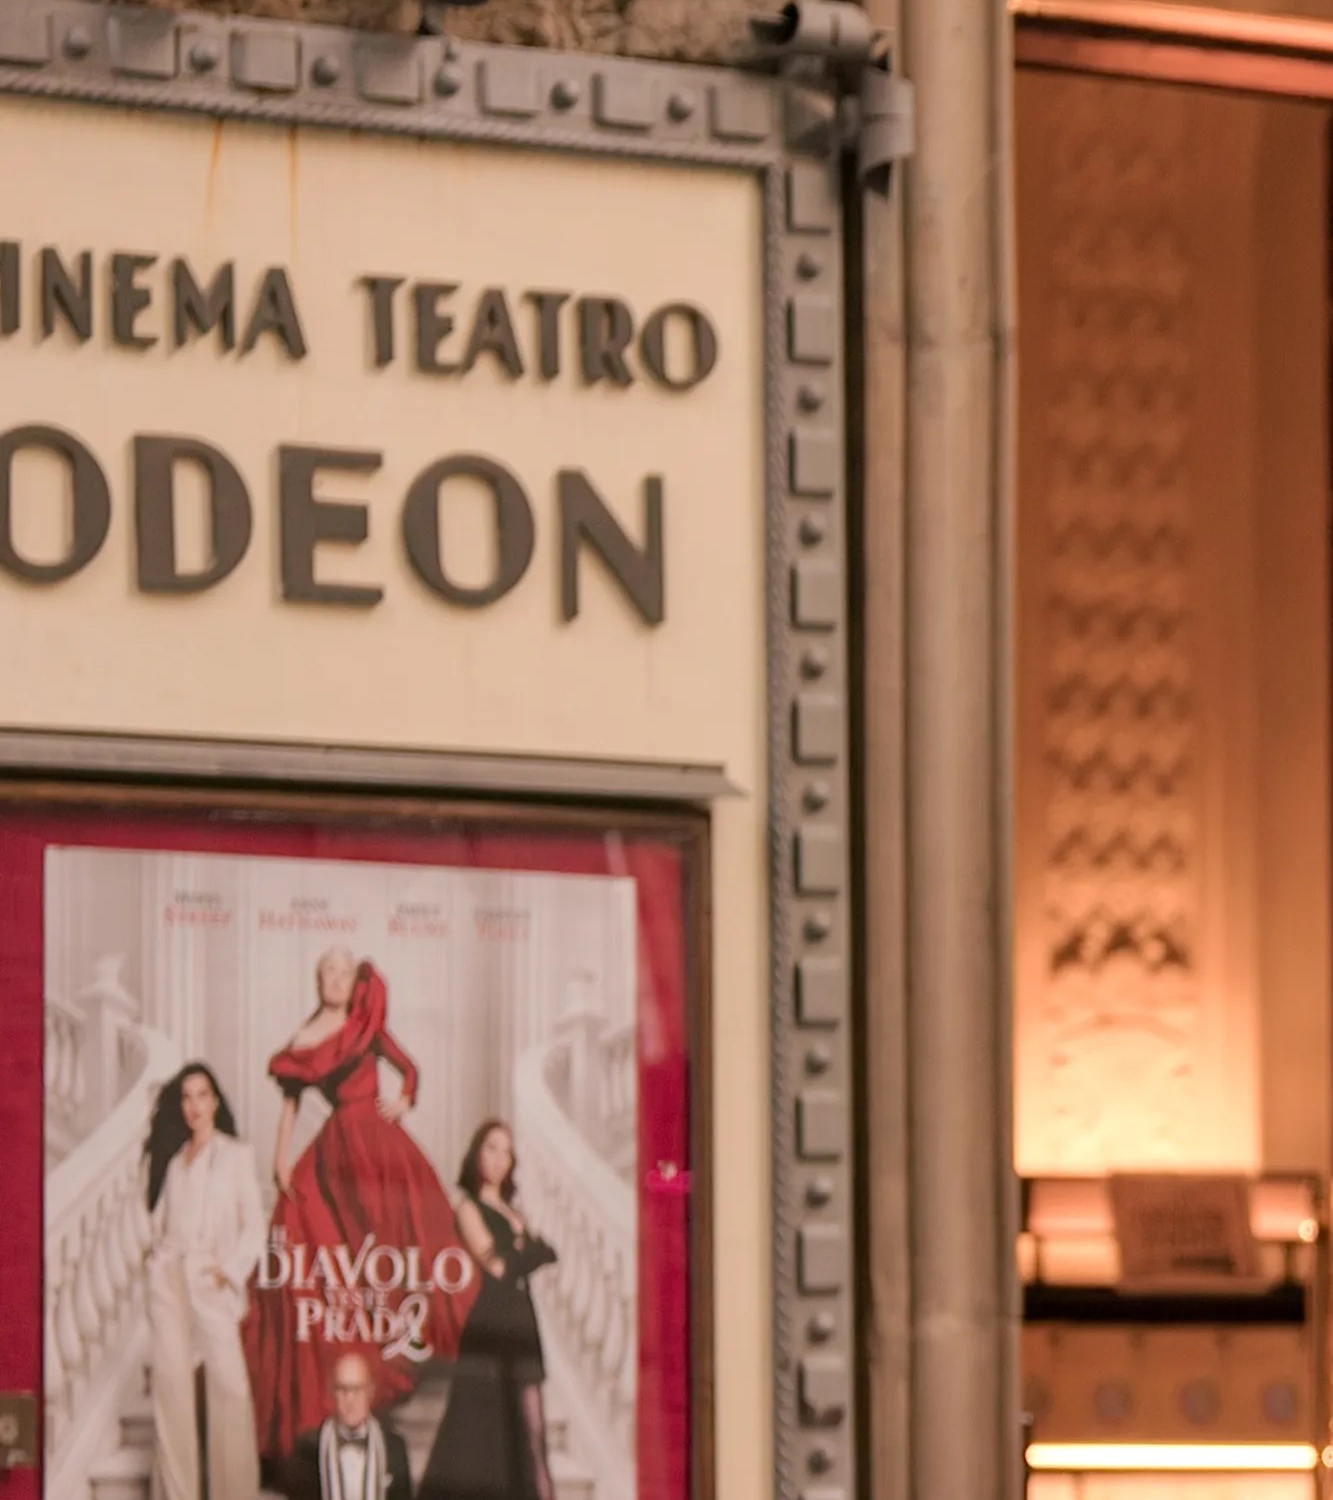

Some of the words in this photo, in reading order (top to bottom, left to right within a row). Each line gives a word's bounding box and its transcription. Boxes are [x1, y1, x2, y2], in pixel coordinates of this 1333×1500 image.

[356, 273, 718, 393] TEATRO
[0, 424, 665, 627] ODEON
[256, 1232, 474, 1295] DIAVOLO
